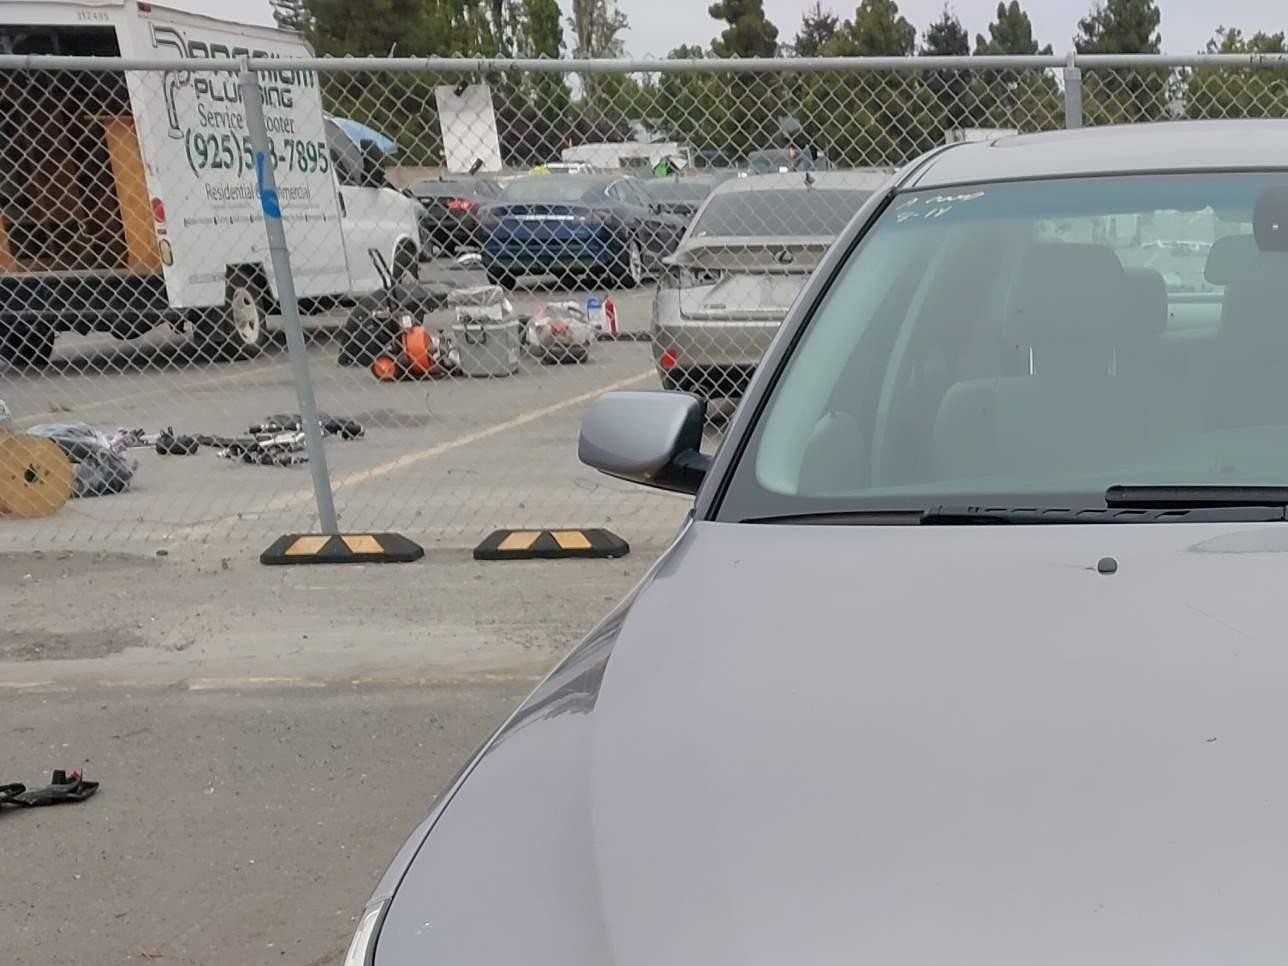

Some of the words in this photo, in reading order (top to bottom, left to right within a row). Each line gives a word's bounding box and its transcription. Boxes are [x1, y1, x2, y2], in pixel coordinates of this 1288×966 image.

[194, 79, 293, 108] PLUING
[199, 103, 244, 130] Service
[264, 115, 295, 134] ooter
[185, 128, 329, 178] (925)5-7895
[205, 183, 254, 200] Residential
